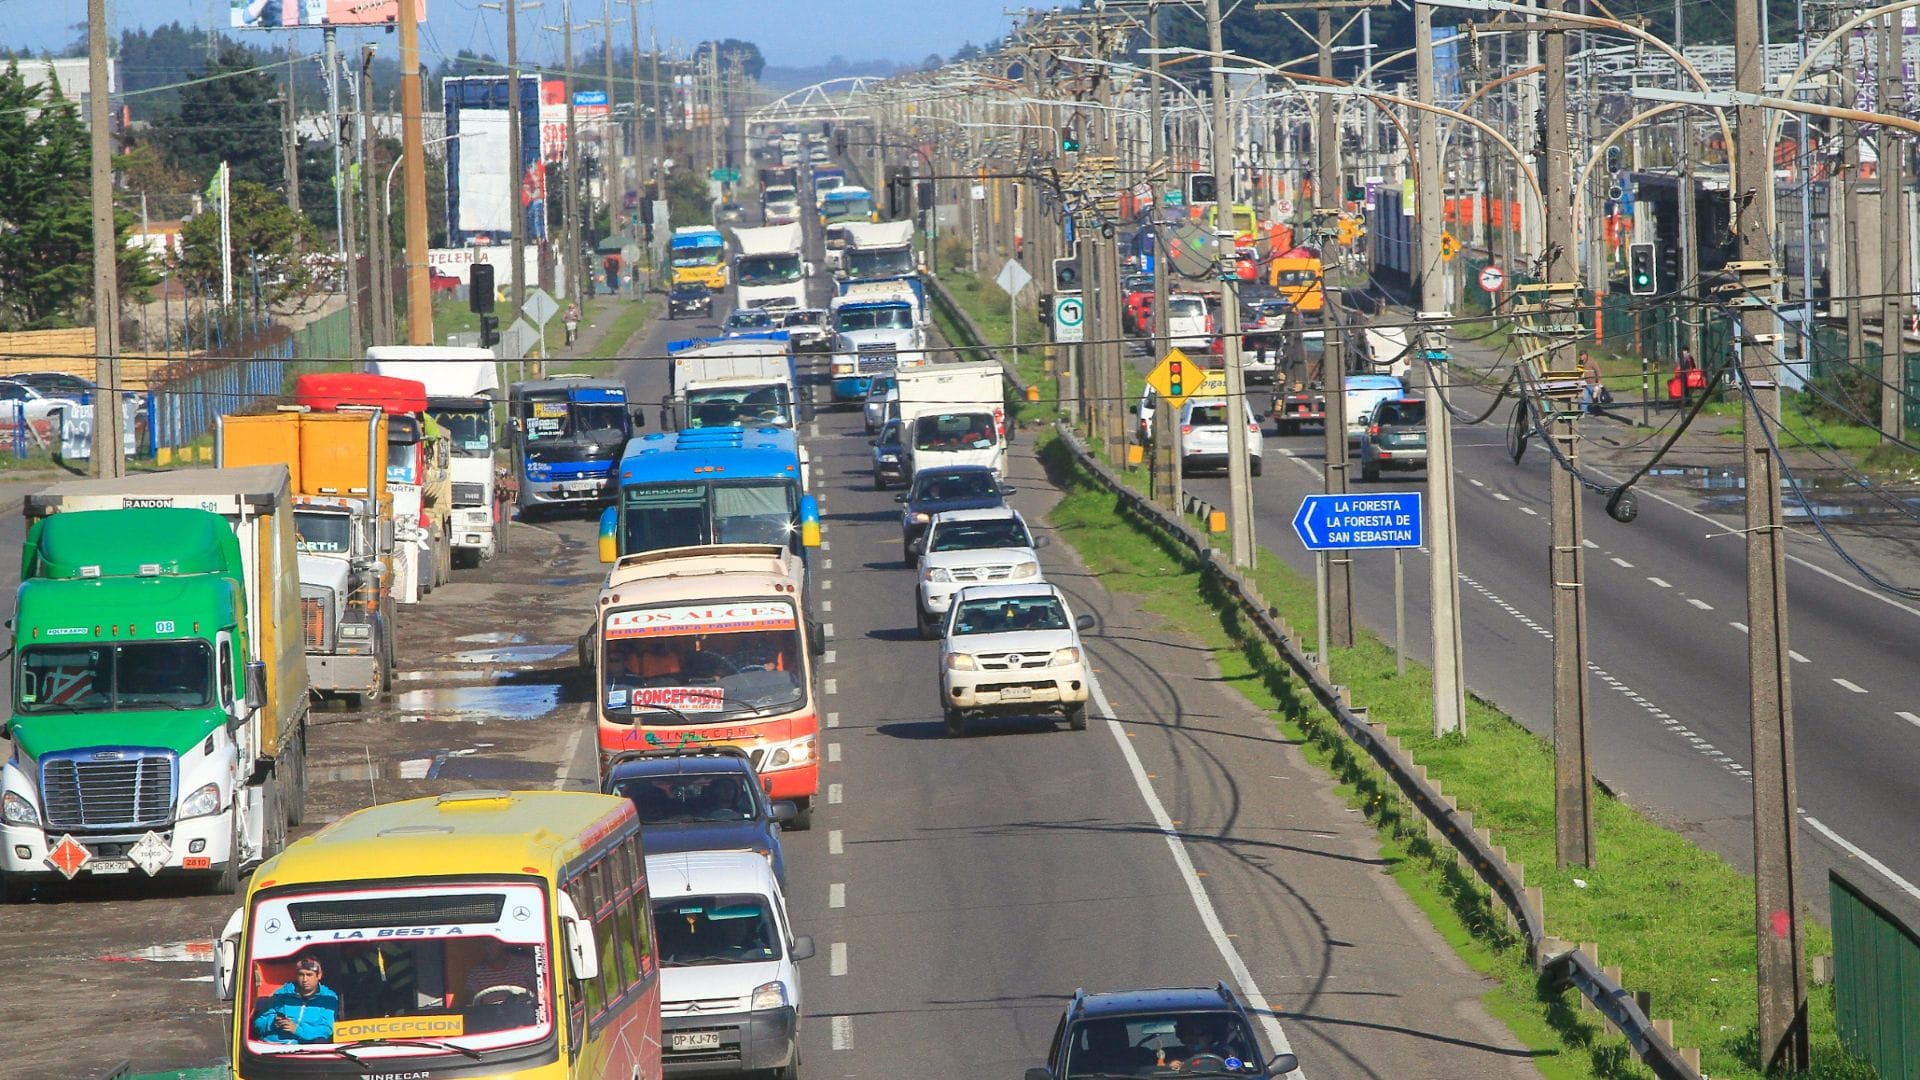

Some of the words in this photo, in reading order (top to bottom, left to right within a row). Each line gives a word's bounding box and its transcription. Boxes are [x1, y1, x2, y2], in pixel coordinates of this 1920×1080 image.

[125, 500, 172, 508] RANDON
[1335, 501, 1349, 513] LA
[1353, 500, 1401, 512] FORESTA
[1327, 517, 1341, 528] LA
[1344, 515, 1393, 527] FORESTA
[1396, 514, 1410, 526] DE
[1328, 531, 1350, 543] SAN
[1353, 530, 1412, 542] SEBASTIAN
[613, 613, 672, 625] LOS
[681, 606, 787, 621] ALCES
[157, 622, 173, 632] 08
[633, 687, 723, 705] CONCEPCION
[333, 931, 364, 940] LA
[335, 1021, 460, 1037] CONCEPCION
[370, 1071, 430, 1080] INRECAR
